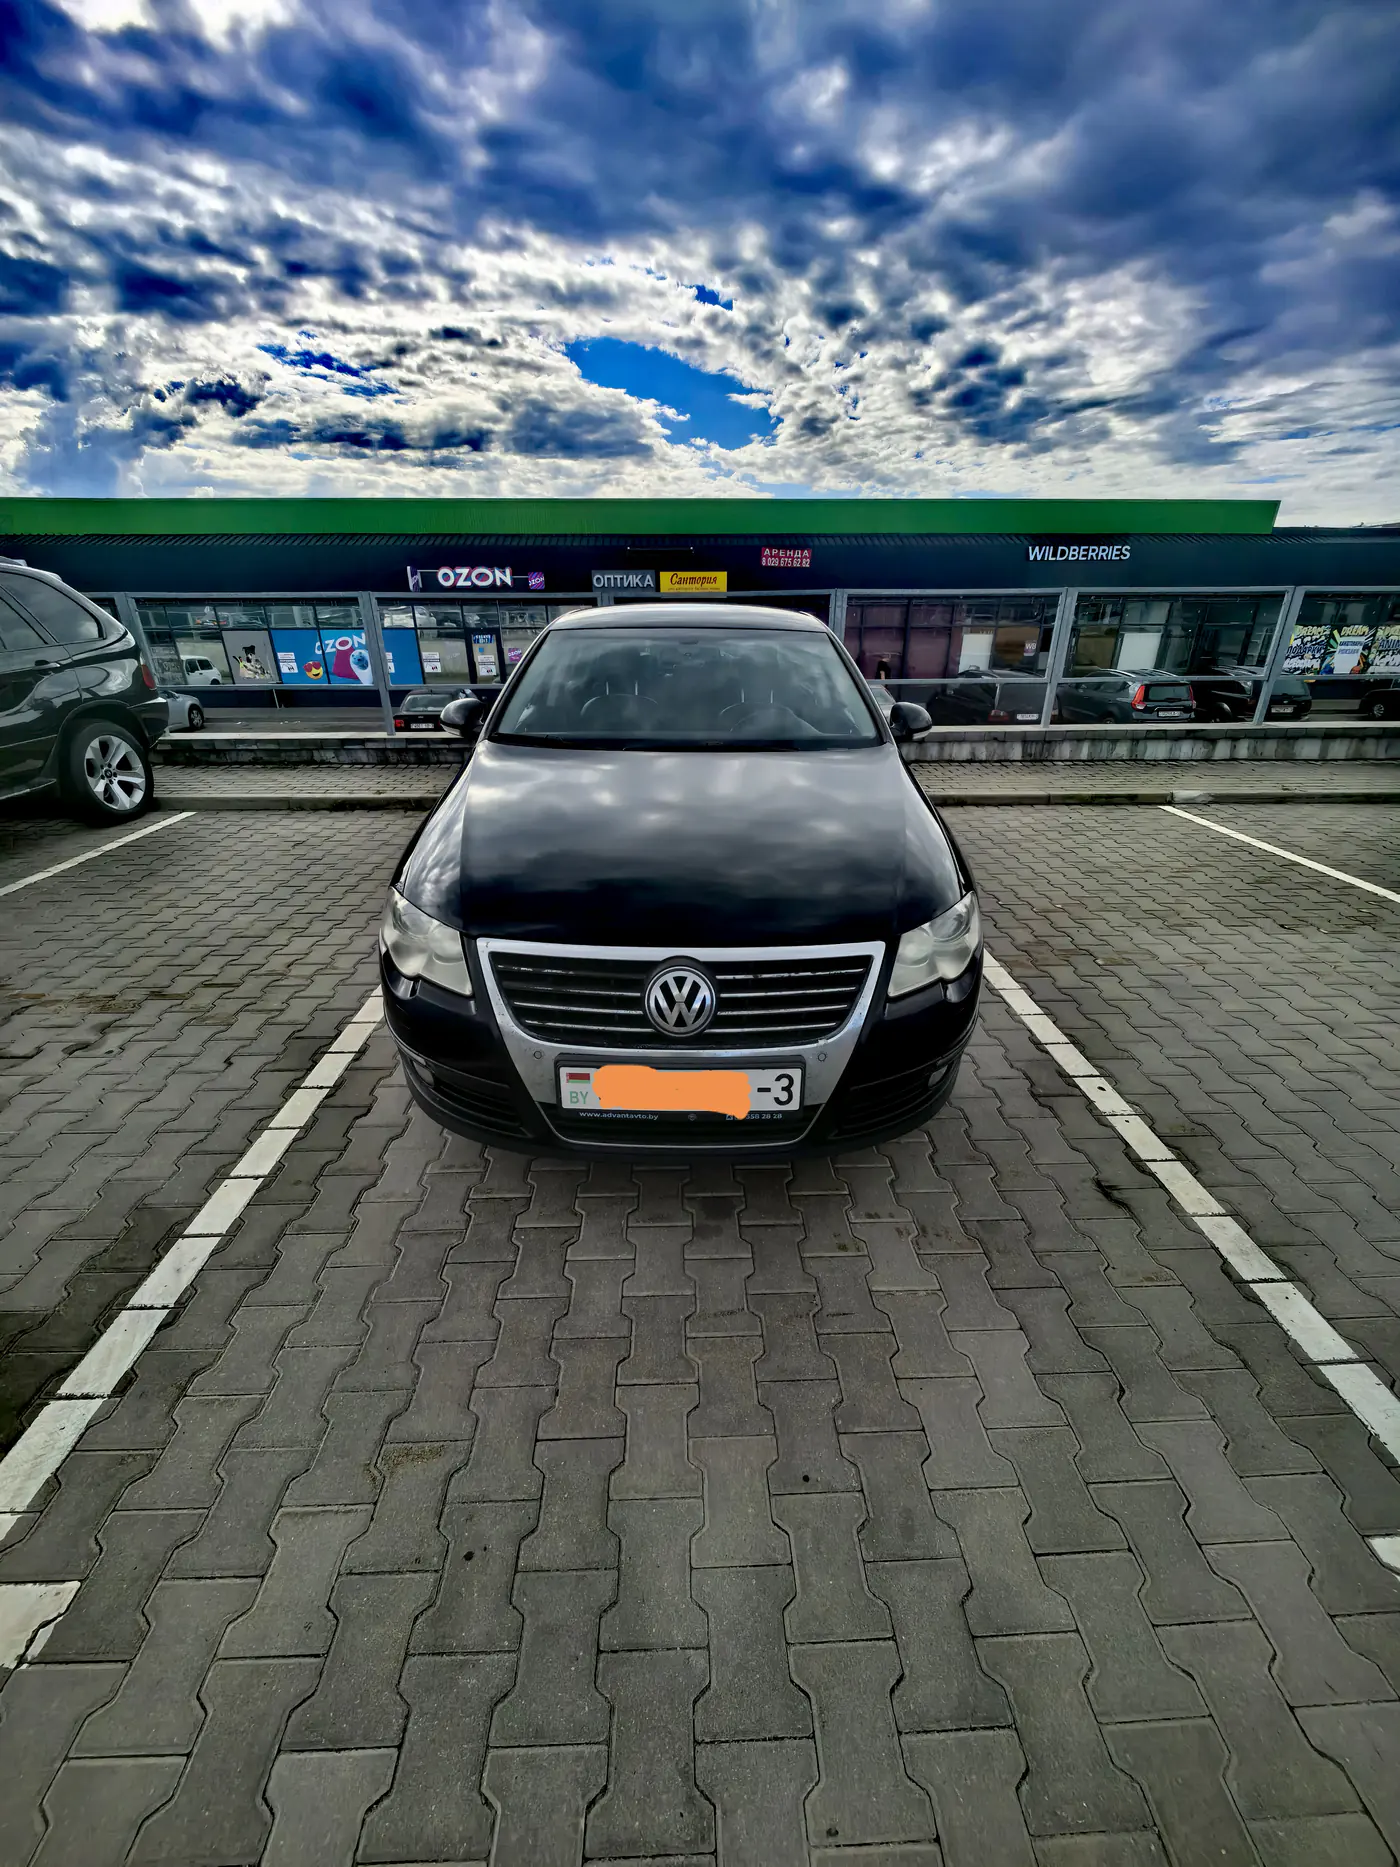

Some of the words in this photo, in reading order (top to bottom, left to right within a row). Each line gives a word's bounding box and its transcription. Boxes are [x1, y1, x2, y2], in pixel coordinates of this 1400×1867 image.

[763, 548, 809, 558] АРЕНДА
[1028, 545, 1131, 561] WILDBERRIES
[768, 558, 779, 566] 029
[780, 557, 792, 567] 675
[437, 566, 513, 588] OZON
[528, 576, 545, 586] OZON
[592, 574, 655, 588] ОПТИКА
[669, 572, 718, 587] Сантория
[1341, 625, 1369, 635] DREAM
[314, 632, 366, 655] OZON
[569, 1090, 588, 1105] BY
[579, 1111, 659, 1121] www.advantavto.by
